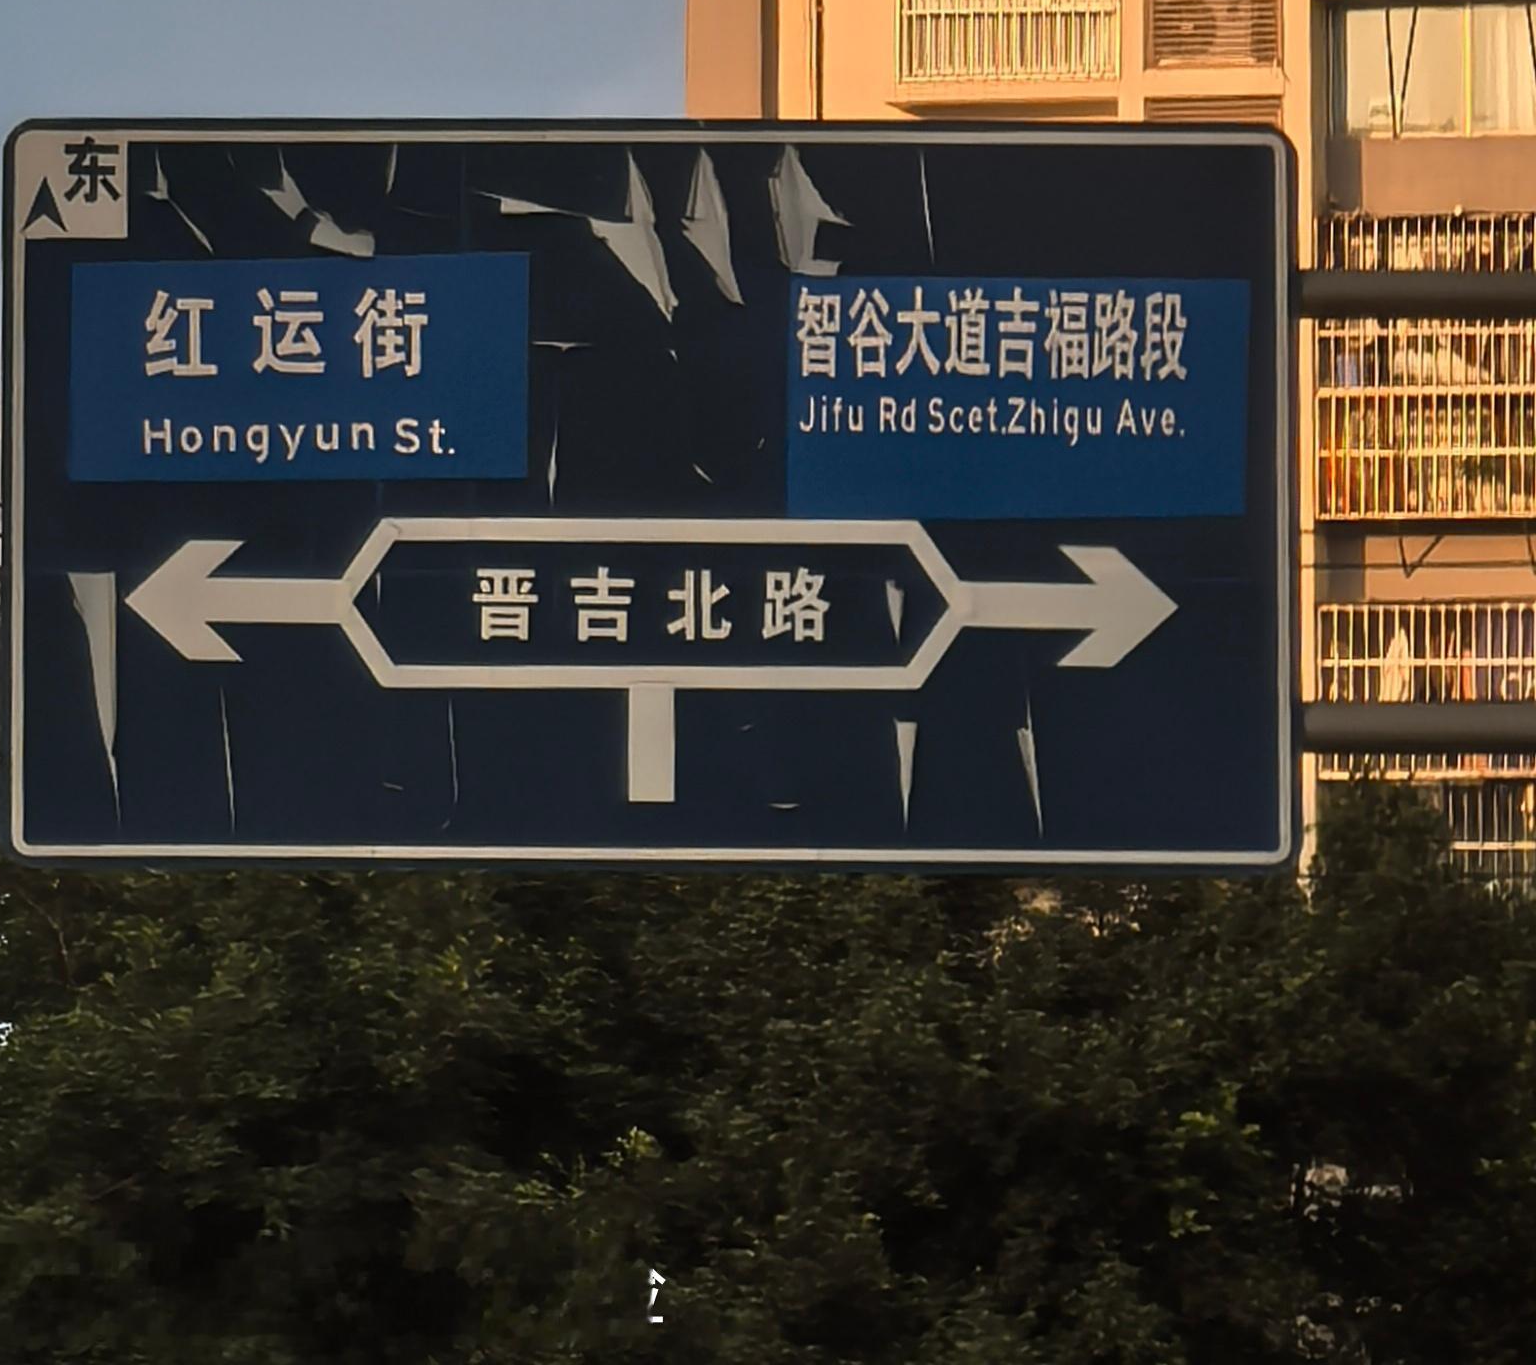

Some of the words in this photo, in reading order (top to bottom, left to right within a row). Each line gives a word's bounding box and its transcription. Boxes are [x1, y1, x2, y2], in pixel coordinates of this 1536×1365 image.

[63, 135, 122, 203] 东
[144, 287, 429, 379] 红运街
[796, 285, 1188, 381] 智谷大道吉福路段
[142, 417, 376, 464] Hongyun
[393, 417, 456, 456] St.
[798, 394, 864, 434] Jifu
[878, 395, 917, 434] Rd
[1115, 397, 1186, 437] Ave.
[471, 566, 831, 643] 晋吉北路
